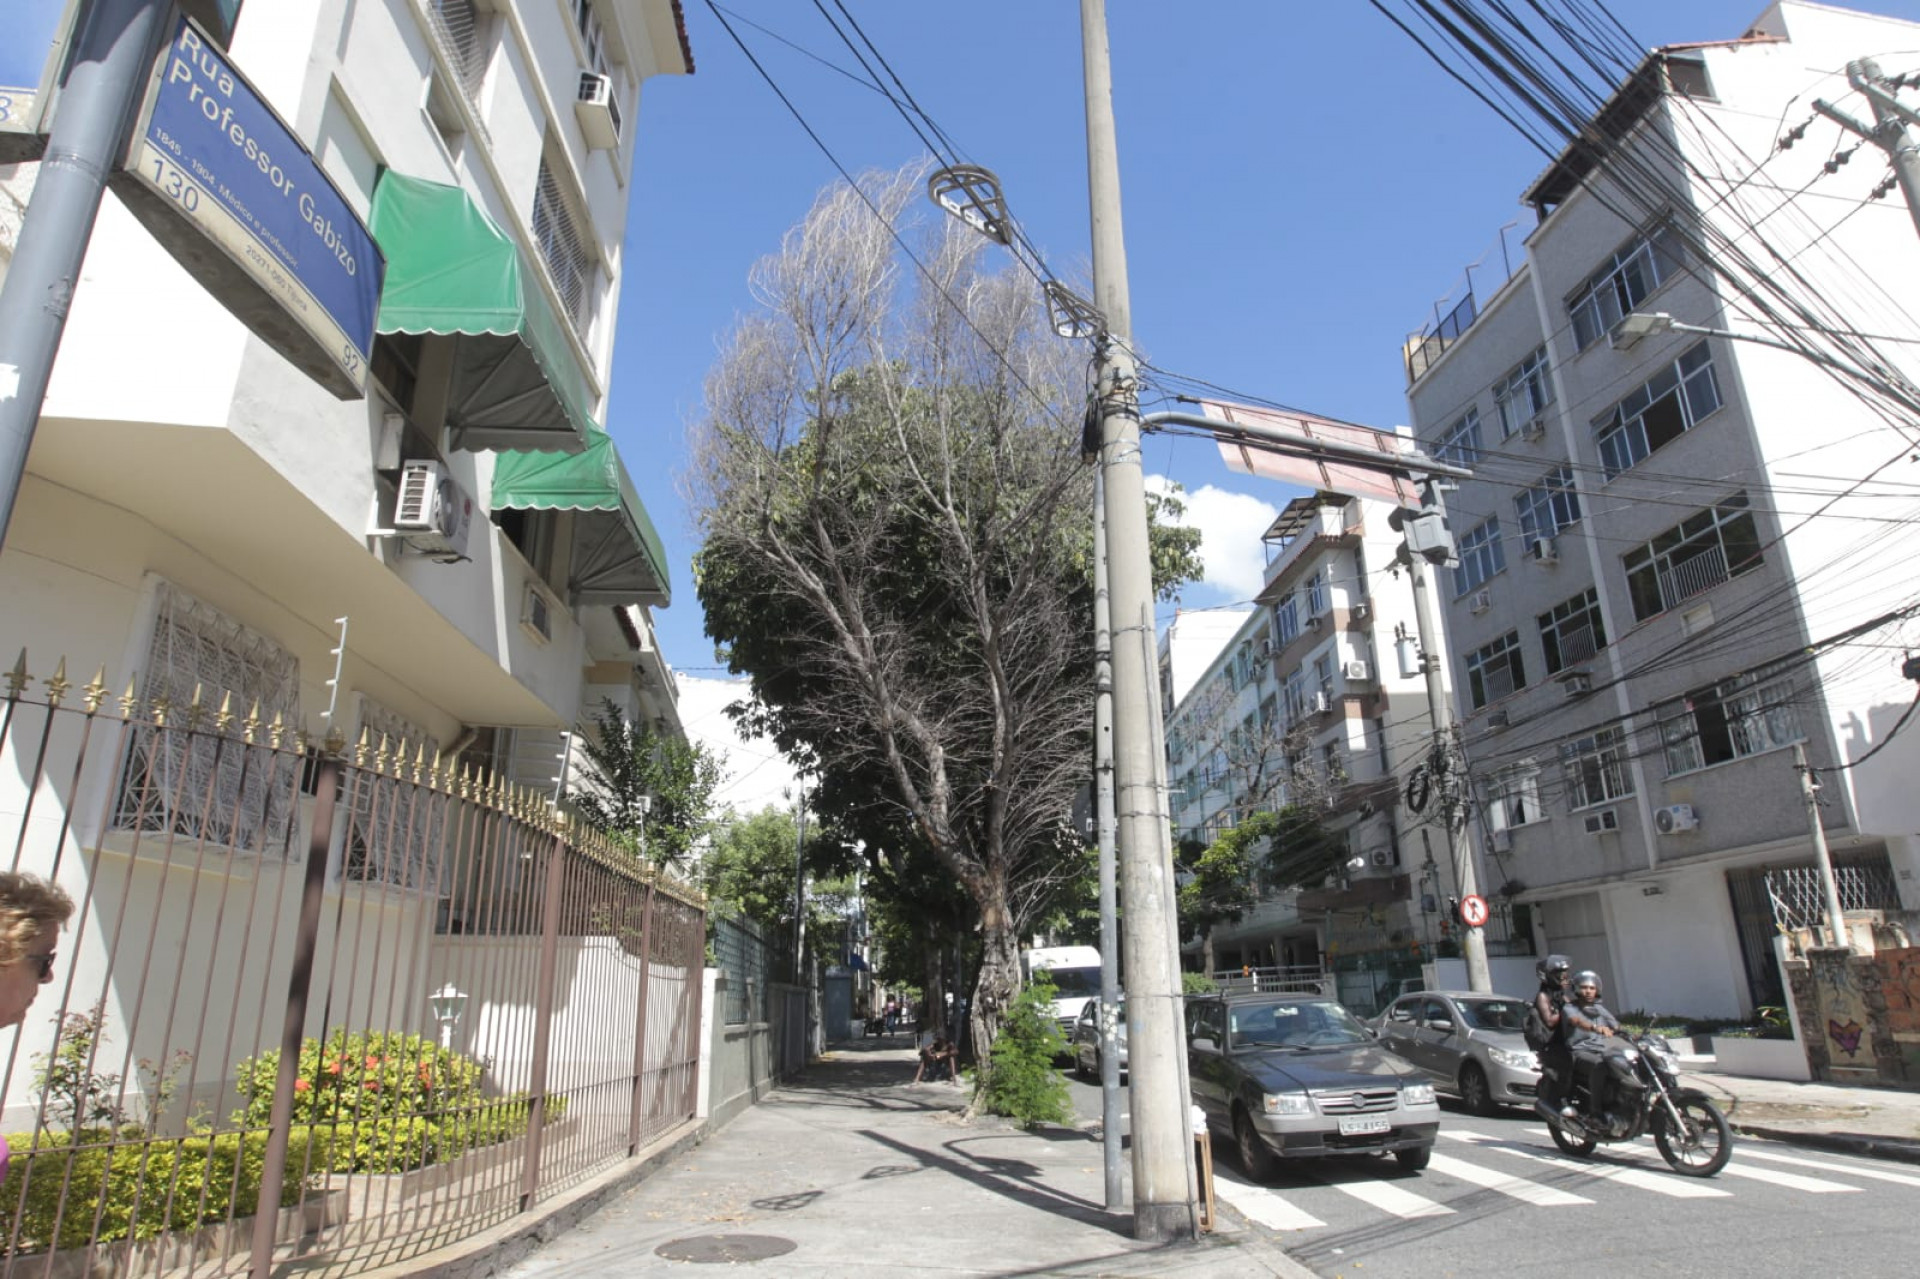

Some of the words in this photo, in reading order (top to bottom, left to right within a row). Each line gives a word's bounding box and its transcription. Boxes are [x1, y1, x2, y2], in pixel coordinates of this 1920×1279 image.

[180, 26, 235, 98] Rua
[156, 127, 181, 155] 1845
[170, 57, 294, 196] Professor
[299, 193, 356, 276] Gabizo
[154, 159, 199, 212] 130
[342, 344, 359, 377] 92
